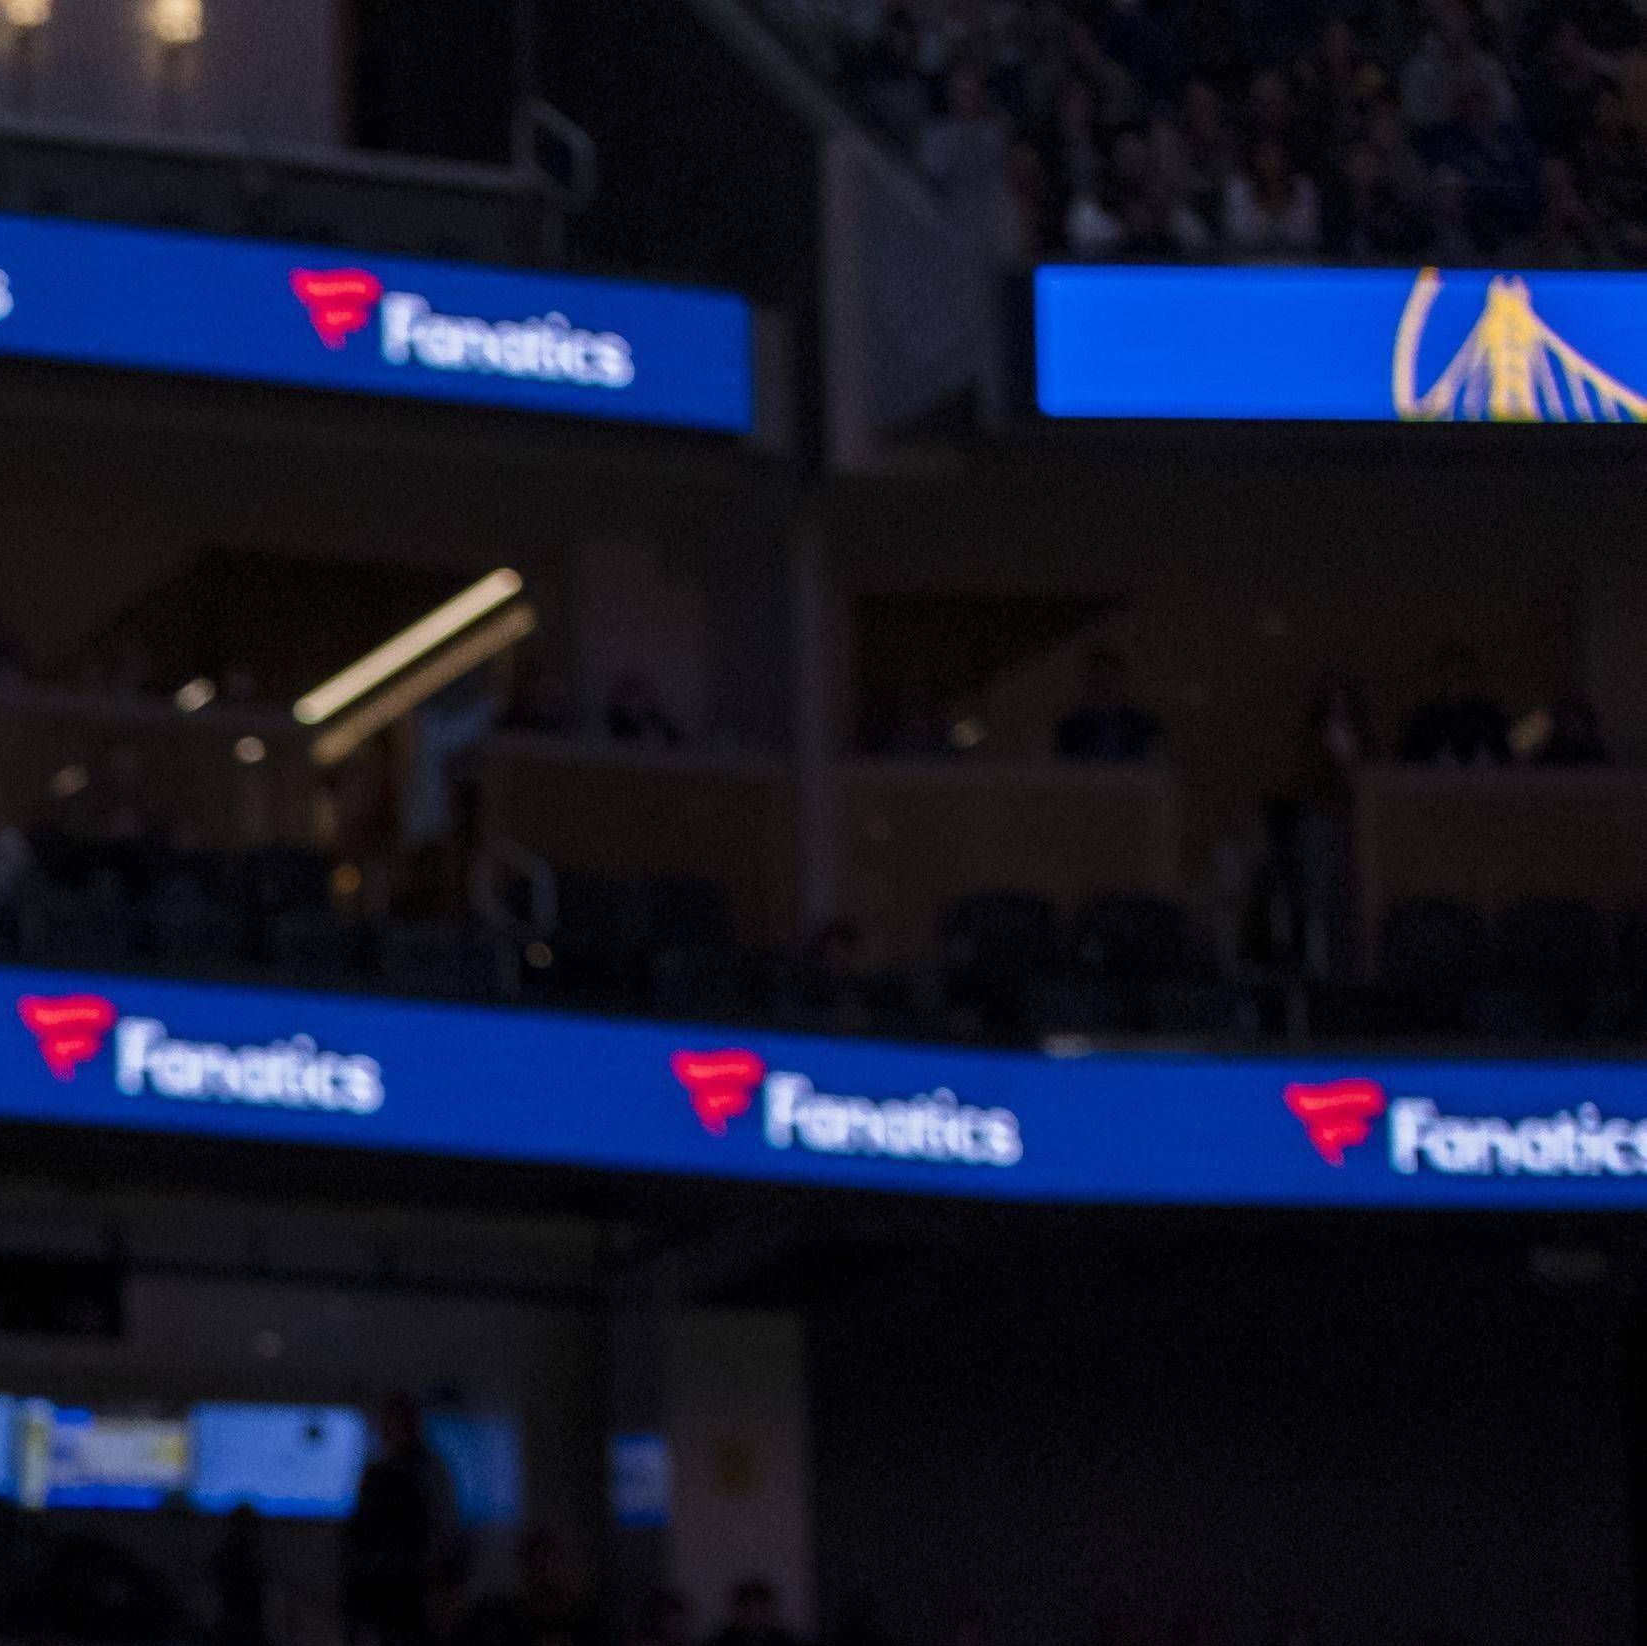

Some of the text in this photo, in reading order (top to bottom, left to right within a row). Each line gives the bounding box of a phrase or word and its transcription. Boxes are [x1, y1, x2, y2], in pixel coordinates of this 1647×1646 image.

[381, 292, 633, 387] Fanatics
[117, 1017, 384, 1114] Fanatics
[766, 1073, 1022, 1165] Fanatics
